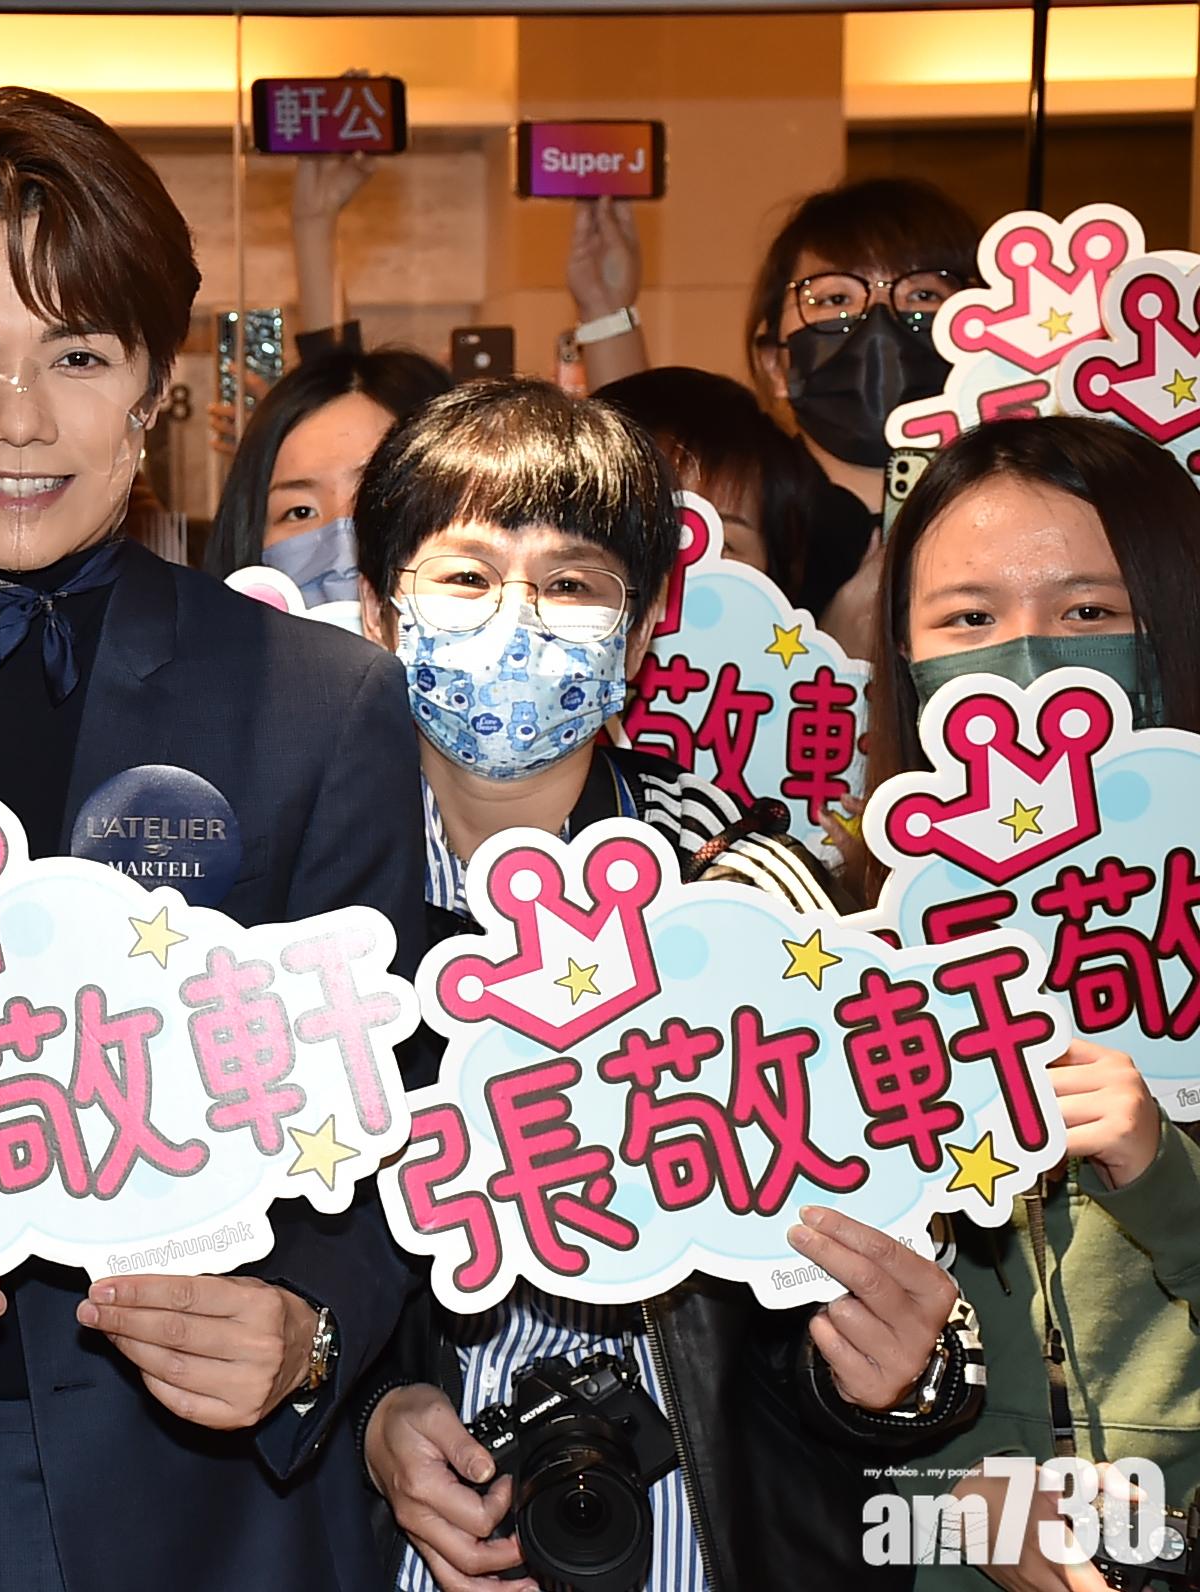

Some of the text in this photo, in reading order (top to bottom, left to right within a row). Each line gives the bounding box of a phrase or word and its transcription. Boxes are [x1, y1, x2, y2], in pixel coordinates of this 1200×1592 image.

[274, 84, 386, 142] 軒公
[541, 146, 645, 176] Super J
[87, 817, 226, 841] L'ATELIER
[108, 861, 206, 879] MARTELL
[400, 946, 1054, 1293] 張敬軒
[107, 1222, 254, 1274] fannyhunghk
[520, 1395, 562, 1424] OLYMPUS
